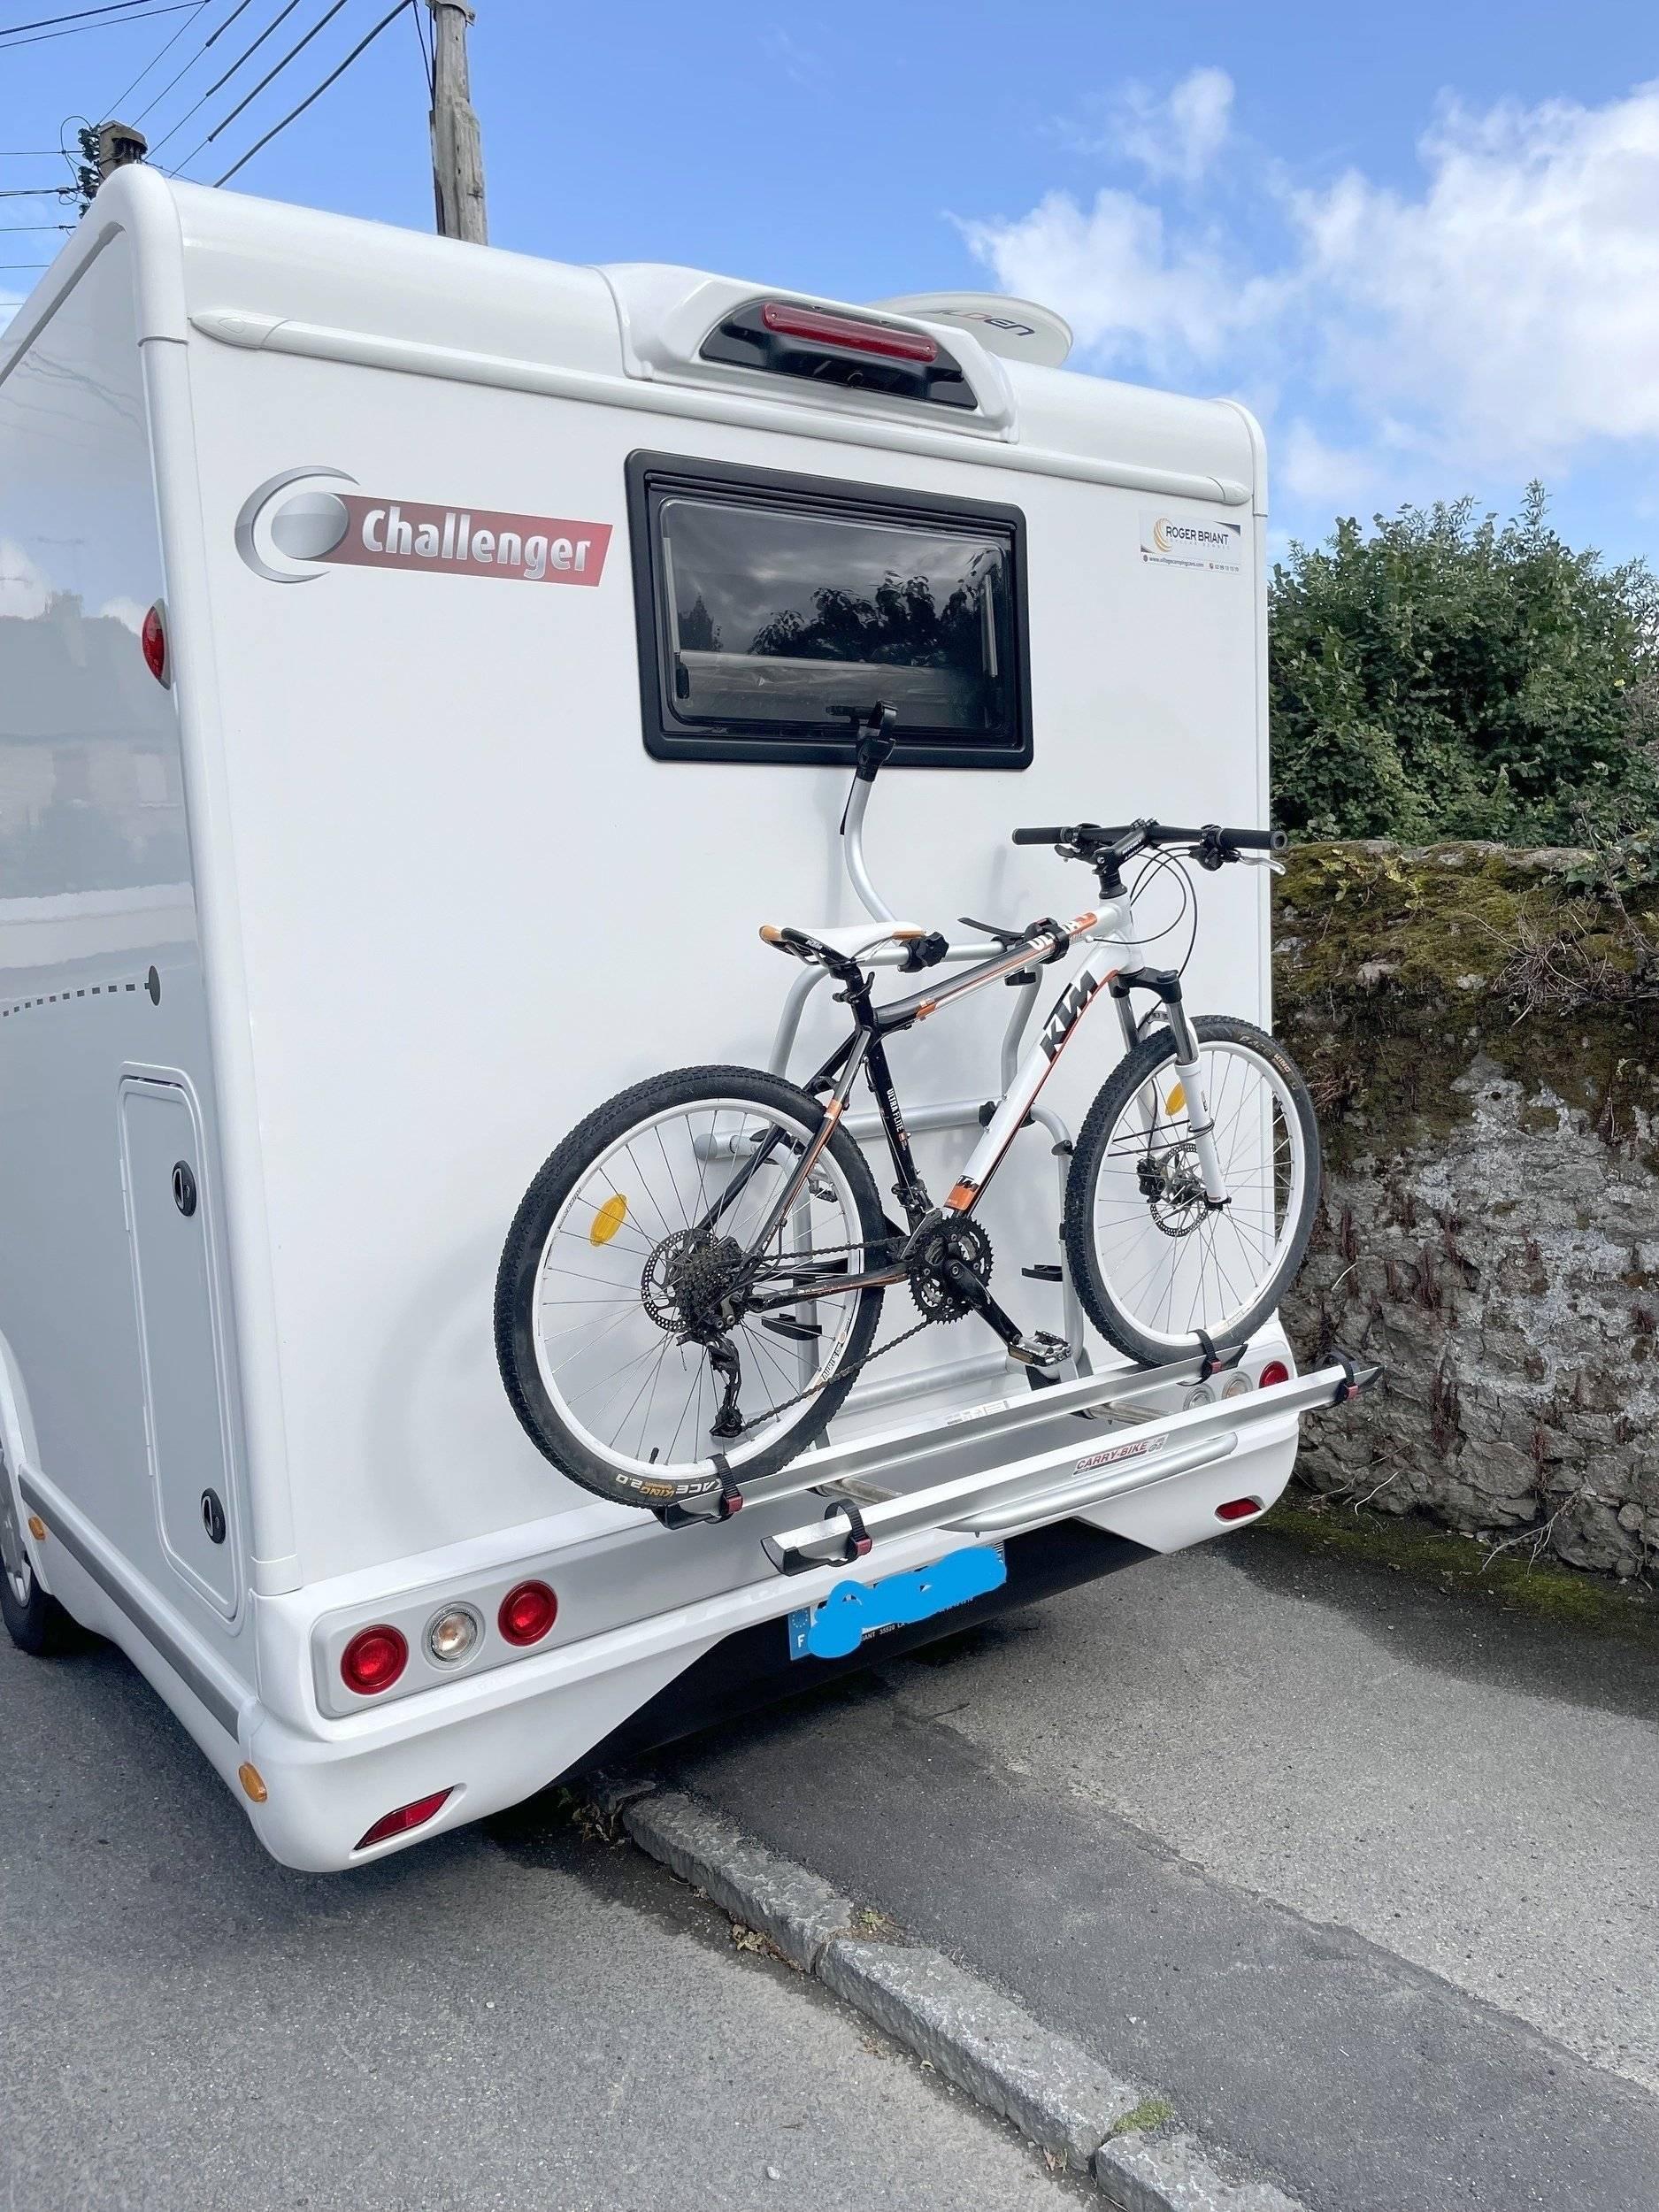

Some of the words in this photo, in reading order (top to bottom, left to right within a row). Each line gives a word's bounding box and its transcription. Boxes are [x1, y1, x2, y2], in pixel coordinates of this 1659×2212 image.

[361, 505, 592, 580] Challenger
[1165, 526, 1197, 541] ROGER
[1198, 531, 1229, 545] BRIANT
[1040, 970, 1098, 1064] KTM
[887, 1088, 899, 1112] ULTRA
[893, 1112, 904, 1133] FLITE
[1076, 1441, 1148, 1469] CARRY-BIKE
[615, 1473, 643, 1489] 2.0
[639, 1486, 676, 1498] KING
[797, 1633, 805, 1648] F
